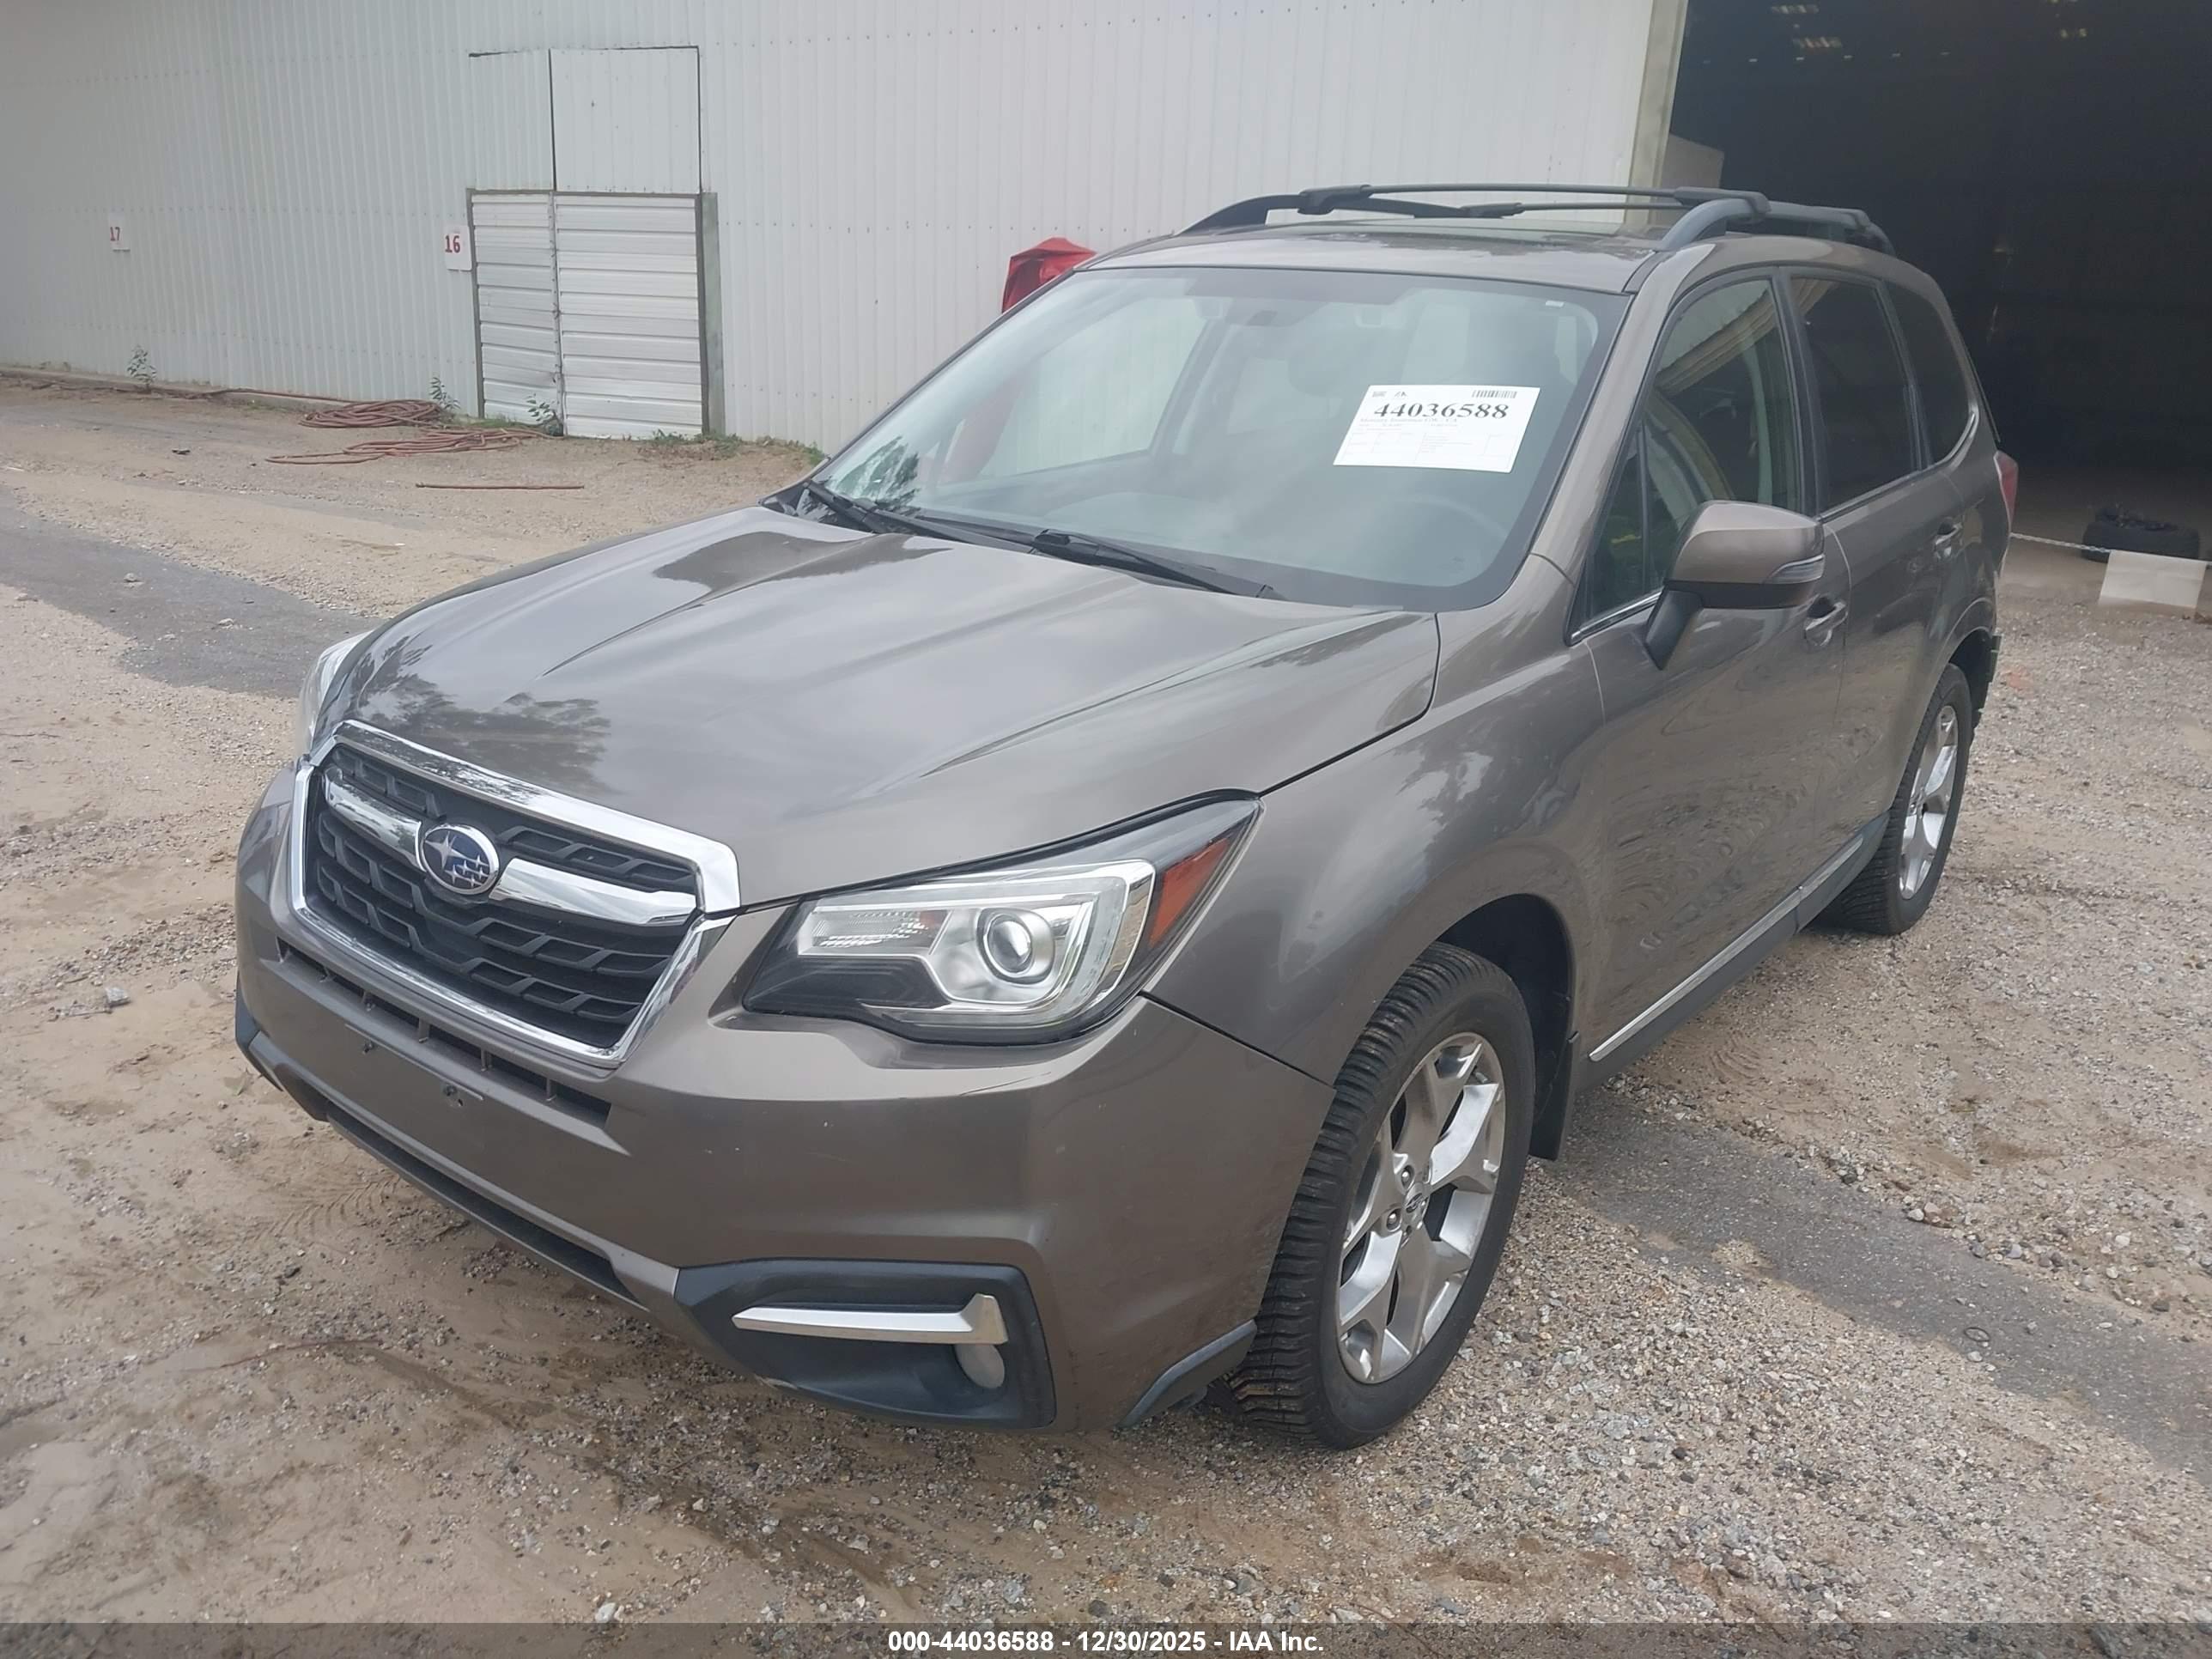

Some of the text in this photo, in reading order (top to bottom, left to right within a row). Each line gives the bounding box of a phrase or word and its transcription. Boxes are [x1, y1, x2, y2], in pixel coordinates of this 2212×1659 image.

[110, 226, 120, 241] 17
[445, 234, 461, 253] 16
[1374, 403, 1510, 419] 44036588
